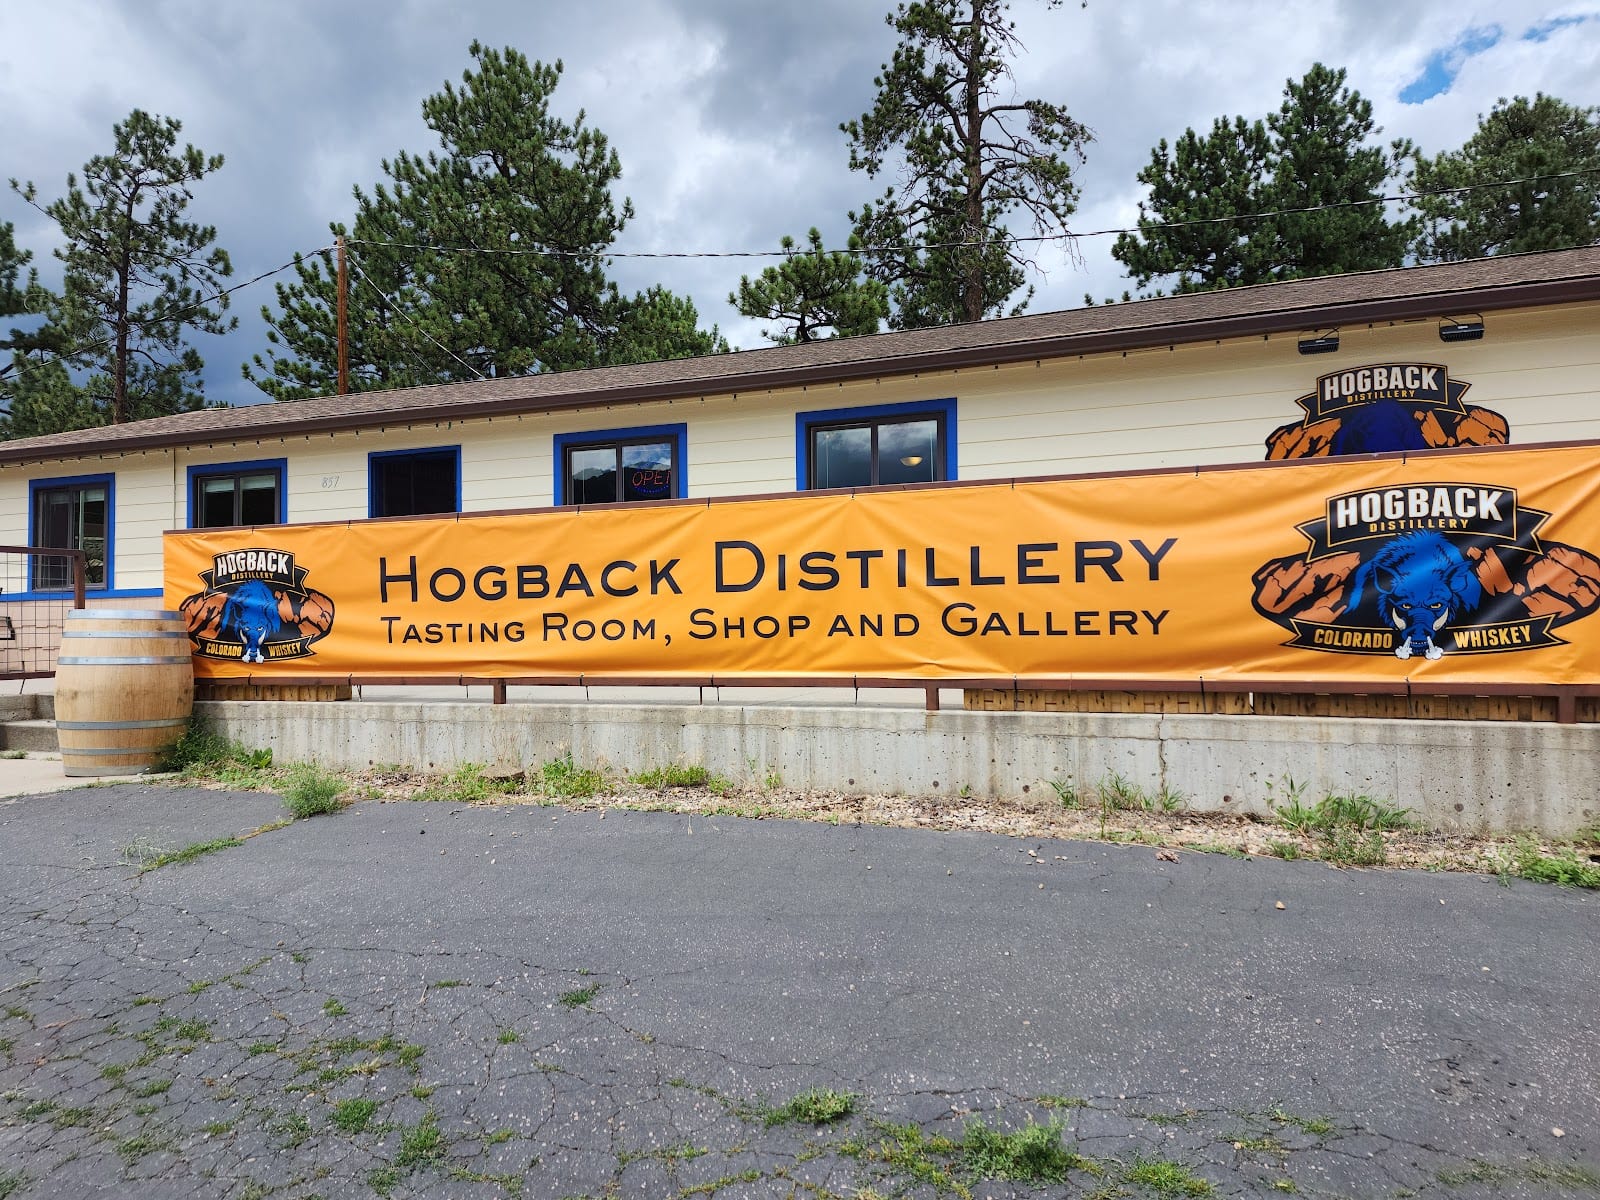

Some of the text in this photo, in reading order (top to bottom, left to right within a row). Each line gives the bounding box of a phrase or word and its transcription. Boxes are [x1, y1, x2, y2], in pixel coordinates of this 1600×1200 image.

[1324, 366, 1439, 401] HOGBACK
[1347, 389, 1415, 402] DISTILLERY
[1336, 487, 1504, 528] HOGBACK
[1369, 518, 1469, 533] DISTILLERY
[216, 551, 289, 576] HOGBACK
[380, 538, 1178, 603] HOGBACK DISTILLERY
[231, 572, 274, 580] DISTILLERY
[380, 602, 1170, 647] TASTING ROOM, SHOP AND GALLERY
[206, 641, 301, 657] COLORADO WHISKEY
[1313, 625, 1532, 649] COLORADO WHISKEY
